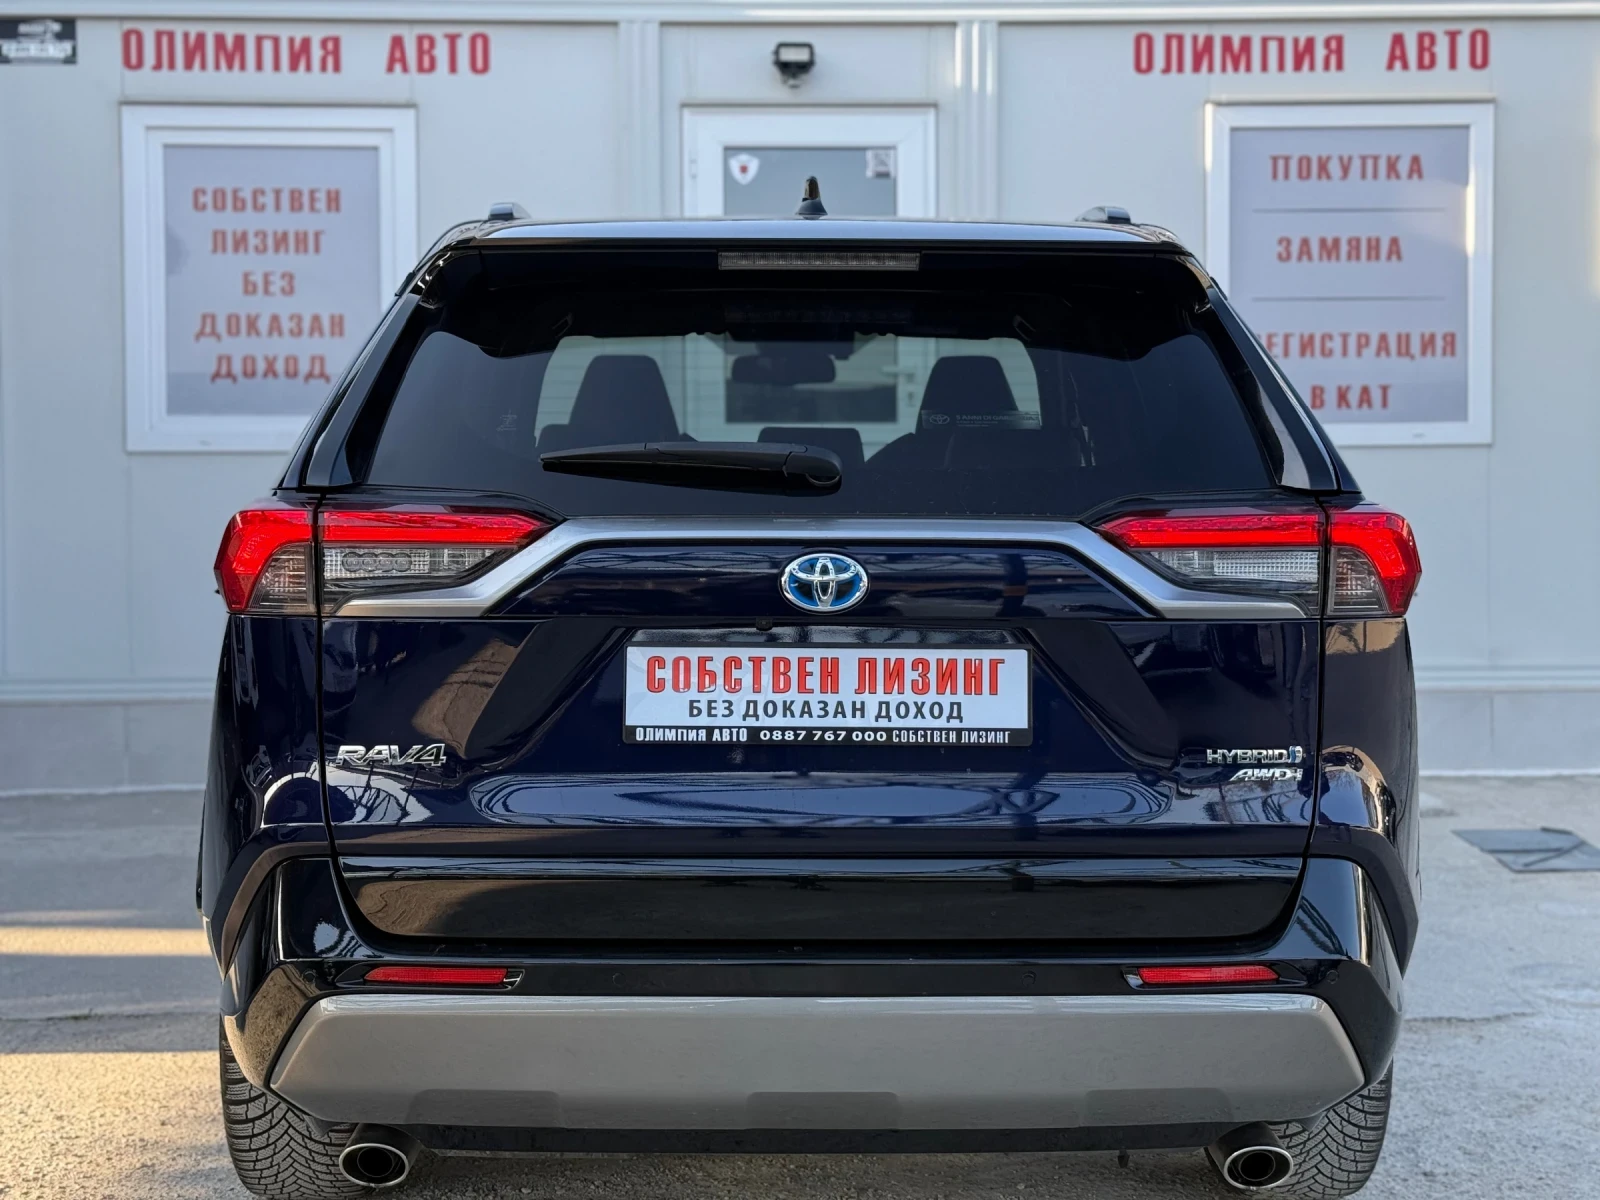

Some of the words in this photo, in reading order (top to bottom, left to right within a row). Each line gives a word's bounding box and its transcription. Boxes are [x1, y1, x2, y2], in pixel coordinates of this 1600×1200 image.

[122, 29, 342, 73] ОЛИМПИЯ
[385, 33, 492, 75] АВТО
[1133, 32, 1345, 75] ОЛИМПИЯ
[1385, 29, 1490, 72] АВТО
[1269, 154, 1424, 182] ПОКУПКА
[192, 187, 342, 214] СОБСТВЕН
[211, 229, 325, 256] ЛИЗИНГ
[1277, 236, 1404, 263] ЗАМЯНА
[242, 271, 296, 297] БЕЗ
[194, 312, 346, 343] ДОКАЗАН
[1257, 331, 1457, 361] ЕГИСТРАЦИЯ
[210, 354, 331, 385] ДОХОД
[1310, 384, 1326, 410] В
[1336, 384, 1392, 410] КАТ
[646, 656, 839, 695] СОБСТВЕН
[854, 657, 1005, 696] ЛИЗИНГ
[688, 699, 734, 718] БЕЗ
[742, 700, 866, 722] ДОКАЗАН
[875, 701, 963, 723] ДОХОД
[635, 727, 707, 742] ОЛИМПИЯ
[712, 727, 748, 742] АВТО
[759, 730, 807, 741] 0887
[812, 730, 847, 741] 767
[852, 731, 887, 742] 000
[892, 730, 956, 743] СОБСТВЕН
[961, 731, 1011, 744] ЛИЗИНГ
[335, 743, 447, 767] RAV4
[1206, 748, 1289, 764] HYBRID
